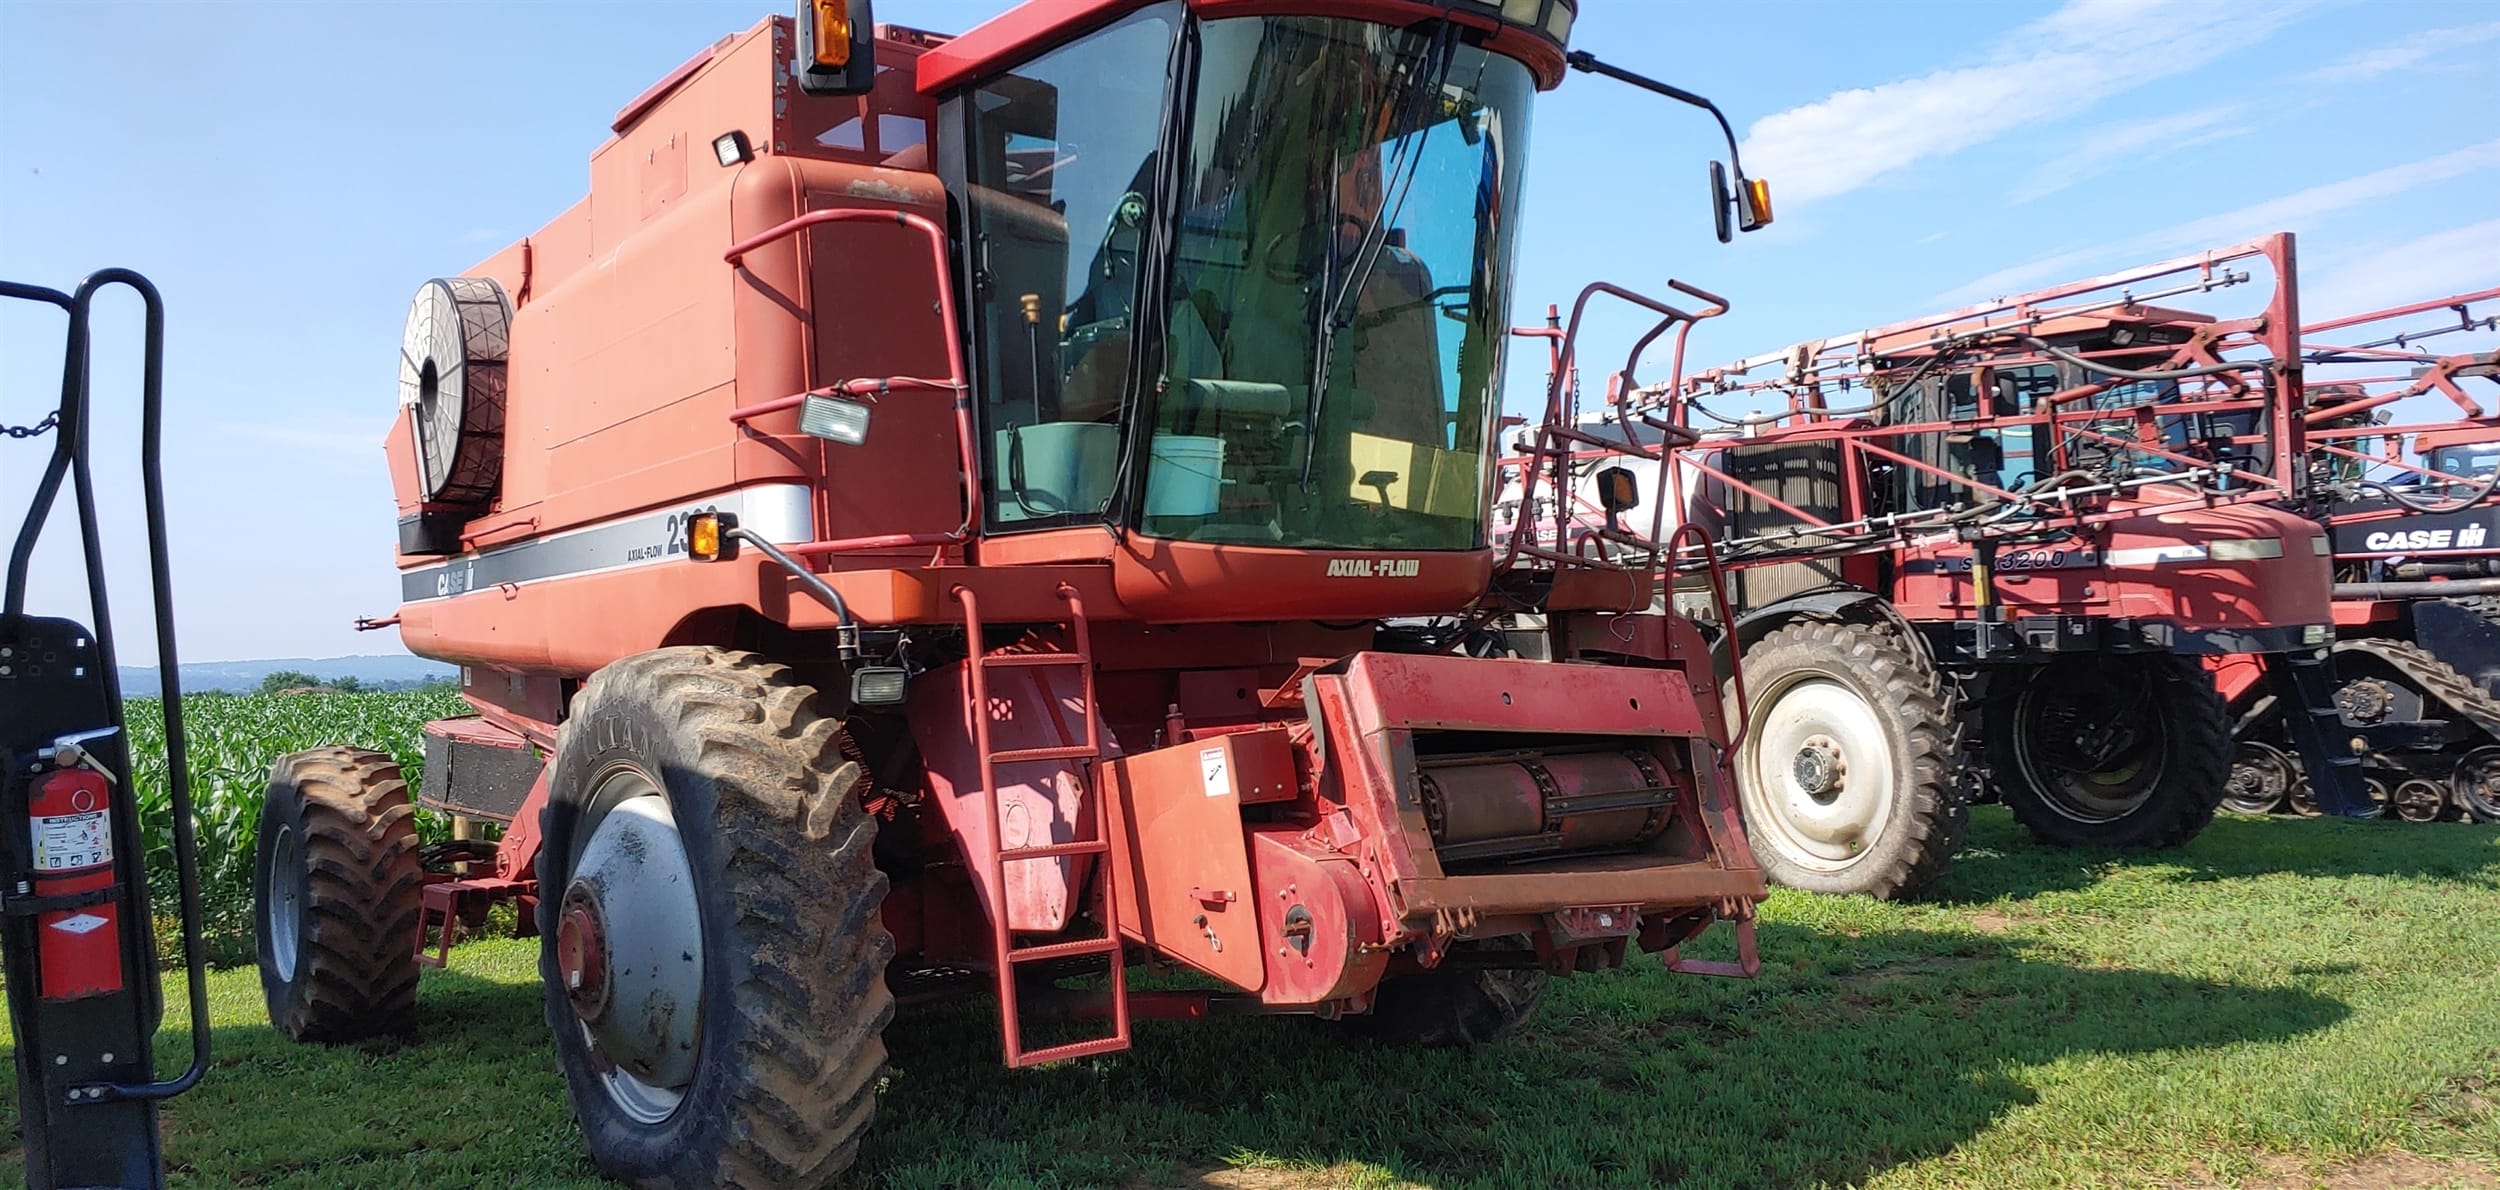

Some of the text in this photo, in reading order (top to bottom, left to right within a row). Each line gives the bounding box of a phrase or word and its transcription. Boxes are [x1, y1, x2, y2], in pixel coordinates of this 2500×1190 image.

[667, 505, 718, 555] 23
[2366, 530, 2453, 550] CASE
[627, 544, 663, 562] AXIAL-FLOW
[1961, 550, 2066, 570] S3200
[1326, 559, 1420, 577] AXIAL-FLOW
[437, 570, 464, 596] CASE
[583, 713, 660, 769] TITAN
